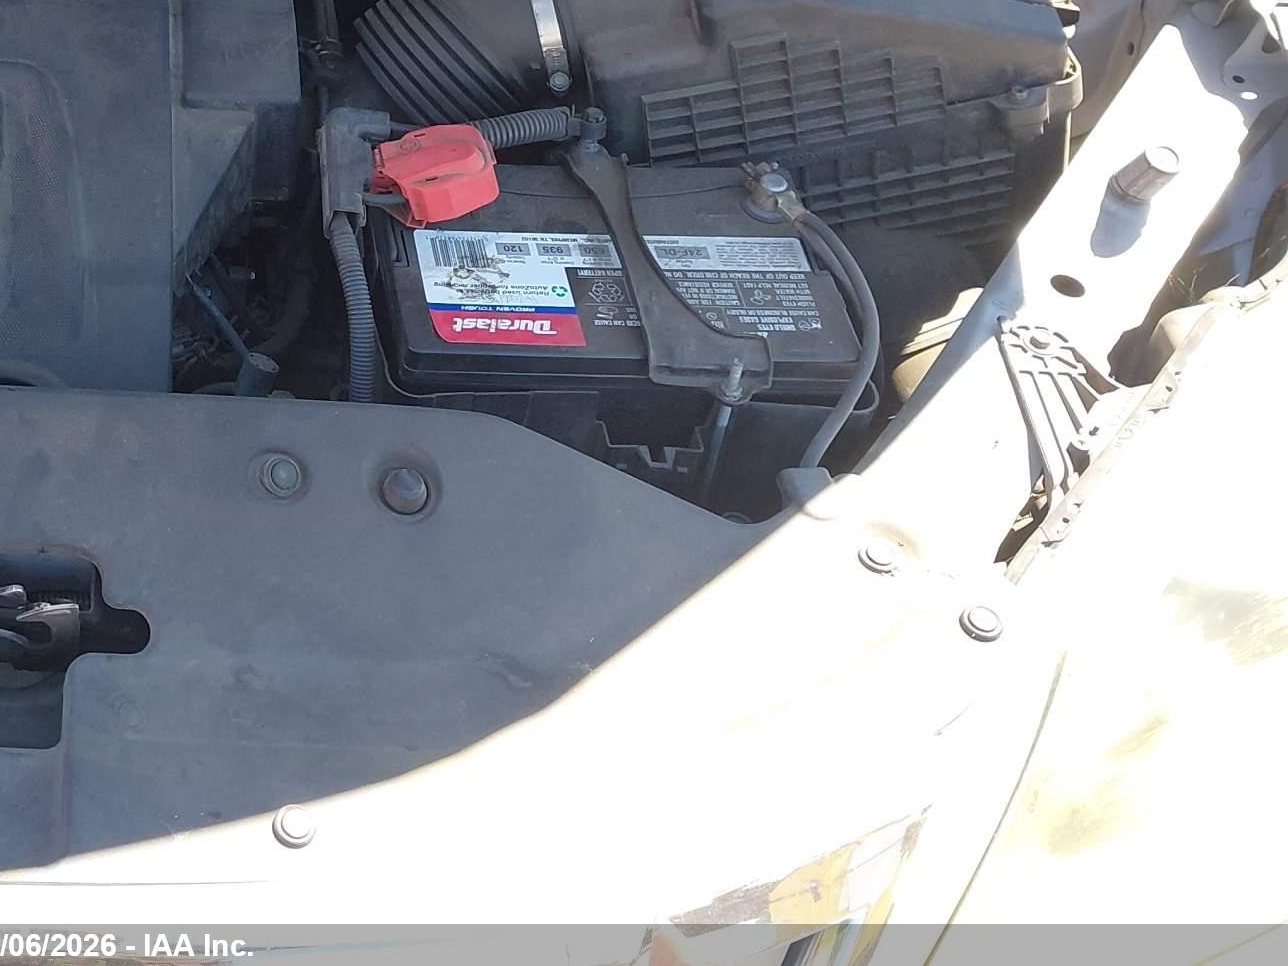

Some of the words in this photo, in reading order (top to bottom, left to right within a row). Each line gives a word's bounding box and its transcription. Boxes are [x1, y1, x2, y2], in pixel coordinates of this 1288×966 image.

[502, 244, 524, 253] 120
[541, 246, 564, 254] 935
[452, 317, 558, 335] Duralast
